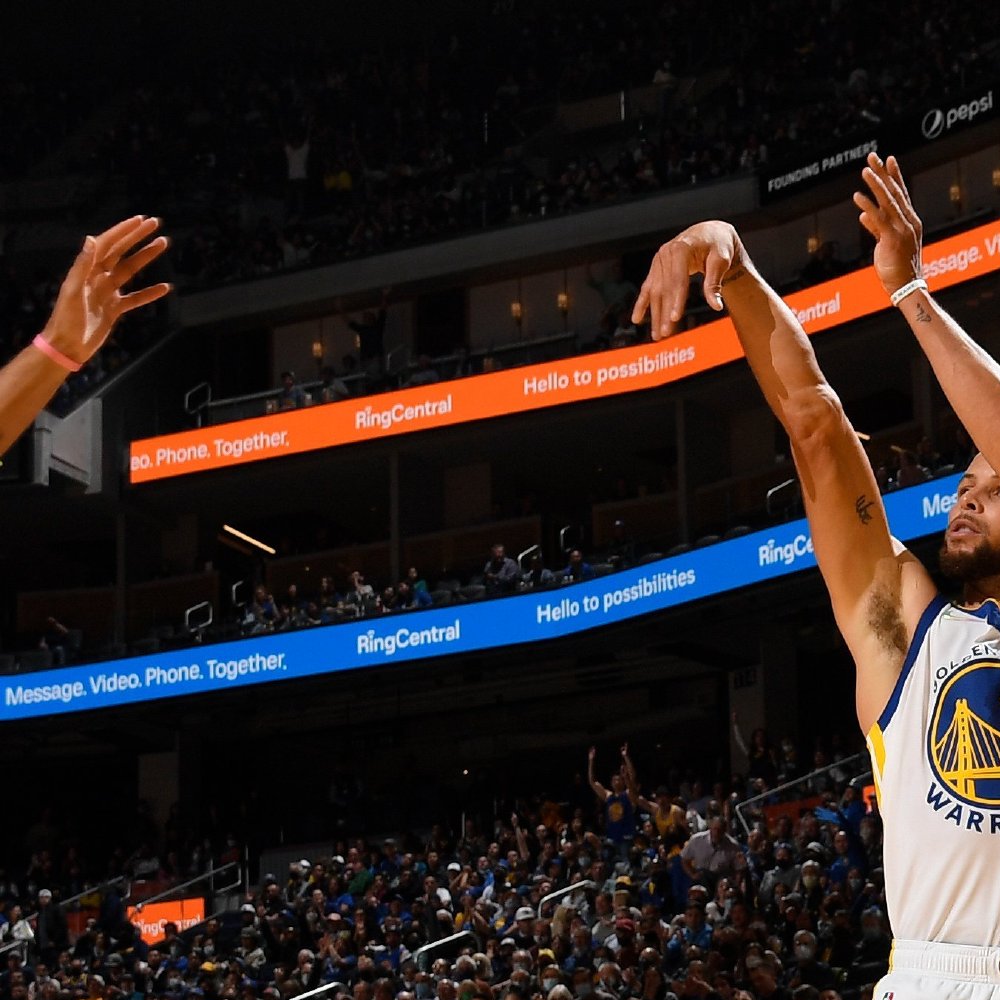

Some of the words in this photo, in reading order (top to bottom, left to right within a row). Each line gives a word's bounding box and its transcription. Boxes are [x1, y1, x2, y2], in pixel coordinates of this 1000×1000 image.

[946, 91, 993, 129] pepsi
[768, 161, 820, 192] FOUNDING
[822, 140, 878, 171] PARTNERS
[922, 247, 983, 280] essage.
[797, 292, 840, 325] entral
[523, 371, 569, 396] Hello
[573, 369, 592, 387] to
[597, 345, 695, 387] possibilities
[355, 394, 452, 430] RingCentral
[156, 443, 211, 466] Phone.
[214, 430, 290, 458] Together.
[758, 538, 813, 566] RingCe
[537, 599, 580, 624] Hello
[583, 593, 600, 612] to
[603, 569, 696, 613] possibilities
[357, 620, 460, 655] RingCentral
[5, 681, 87, 706] Message.
[89, 672, 142, 694] Video.
[145, 664, 204, 687] Phone.
[206, 653, 287, 681] Together.
